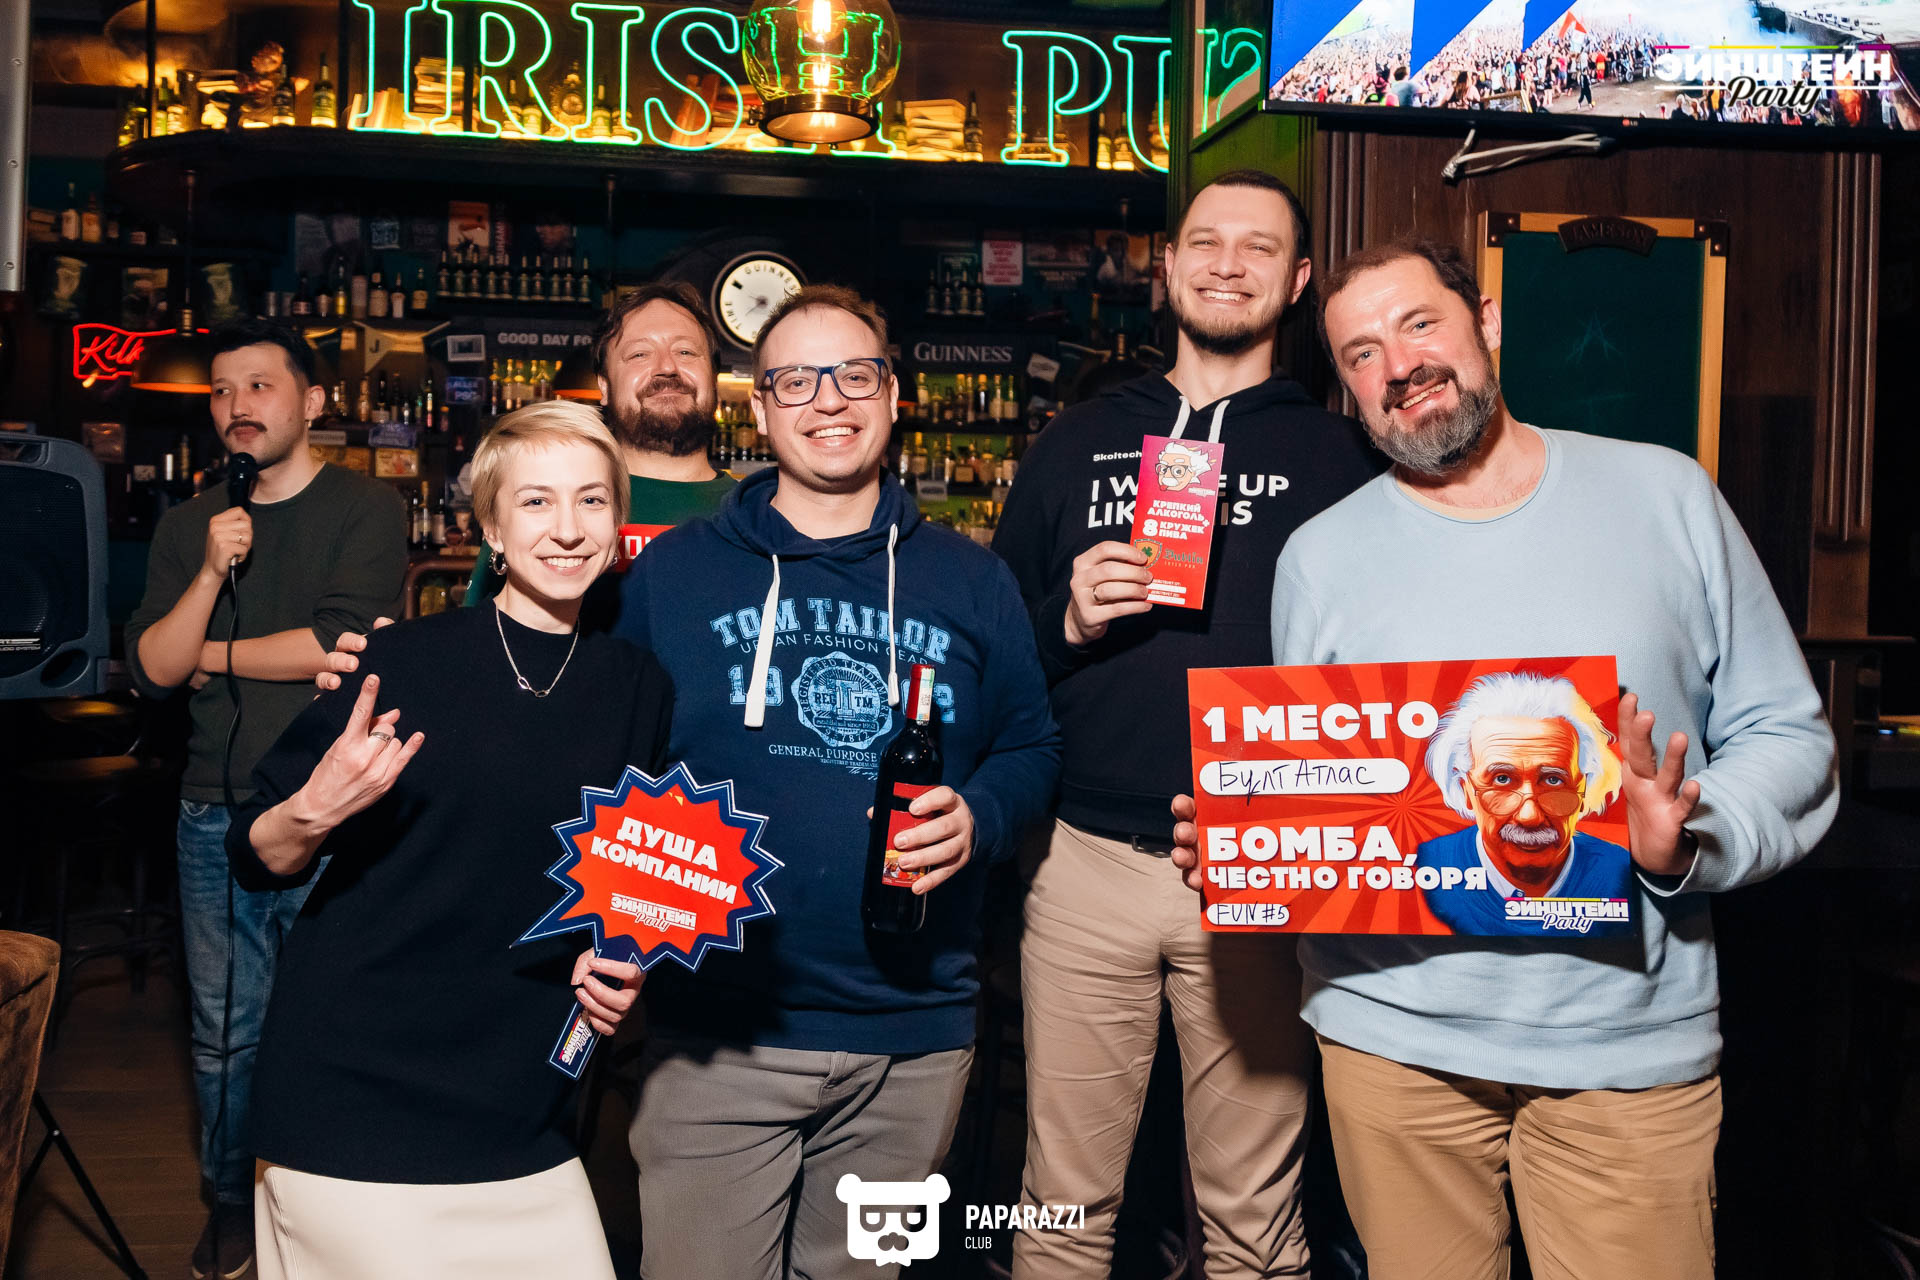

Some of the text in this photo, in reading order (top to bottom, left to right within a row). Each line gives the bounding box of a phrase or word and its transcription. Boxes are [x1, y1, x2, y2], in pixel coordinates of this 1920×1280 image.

[1727, 76, 1821, 115] Party
[1565, 221, 1650, 248] JAMESON
[744, 264, 798, 292] GUINNES
[725, 301, 742, 330] TIME
[498, 332, 539, 345] GOOD
[542, 333, 570, 346] DAY
[913, 341, 1014, 363] GUINNESS
[1093, 450, 1142, 462] Skoltech
[1092, 480, 1100, 502] I
[1239, 474, 1290, 497] UP
[1153, 500, 1201, 513] КРЕПКИЙ
[1143, 518, 1206, 537] 8 КРУЖЕК
[1158, 529, 1188, 540] ПИВА
[1163, 549, 1204, 565] Dublin
[710, 597, 951, 665] TOM TAILOR
[740, 634, 797, 654] UAN
[804, 633, 879, 654] FASHION
[799, 658, 889, 720] REGISTERED TRADEMARK
[854, 696, 873, 708] TM
[1202, 700, 1440, 743] 1 МЕСТО
[768, 744, 878, 762] GENERAL PURPOSE
[616, 816, 718, 872] ДУША
[1206, 825, 1418, 867] БОМБА,
[590, 836, 738, 904] КОМПАНИИ
[1207, 865, 1488, 890] ЧЕСТНО ГОВОРЯ
[634, 911, 674, 932] Party
[1216, 901, 1291, 925] FUN #5
[1542, 913, 1595, 933] Party
